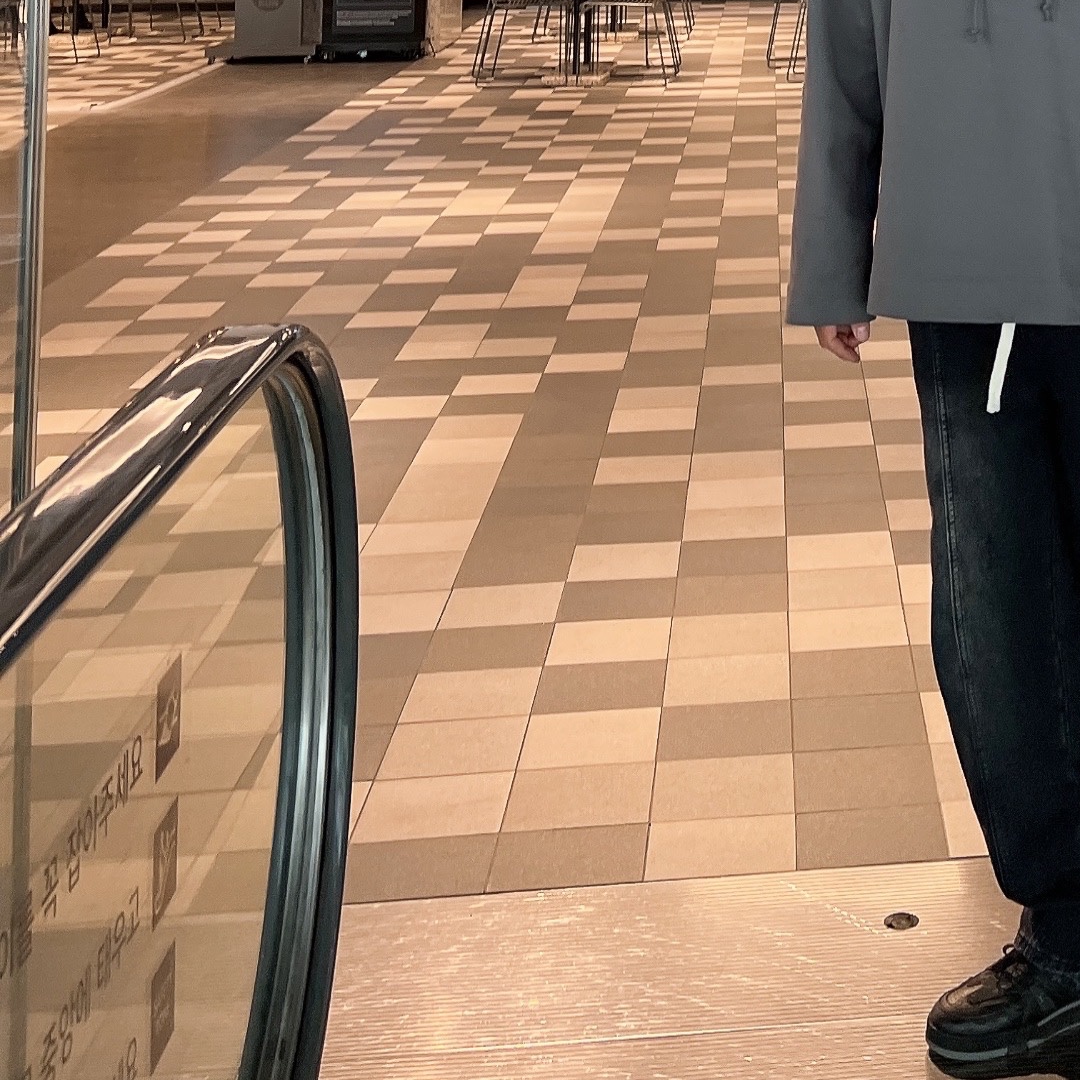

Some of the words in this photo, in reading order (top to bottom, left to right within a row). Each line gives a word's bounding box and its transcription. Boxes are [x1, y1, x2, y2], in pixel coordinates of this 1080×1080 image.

[41, 854, 60, 919] 꼭
[66, 734, 144, 894] 잡아주세요
[41, 962, 93, 1080] 중앙에
[96, 885, 141, 992] 태우고
